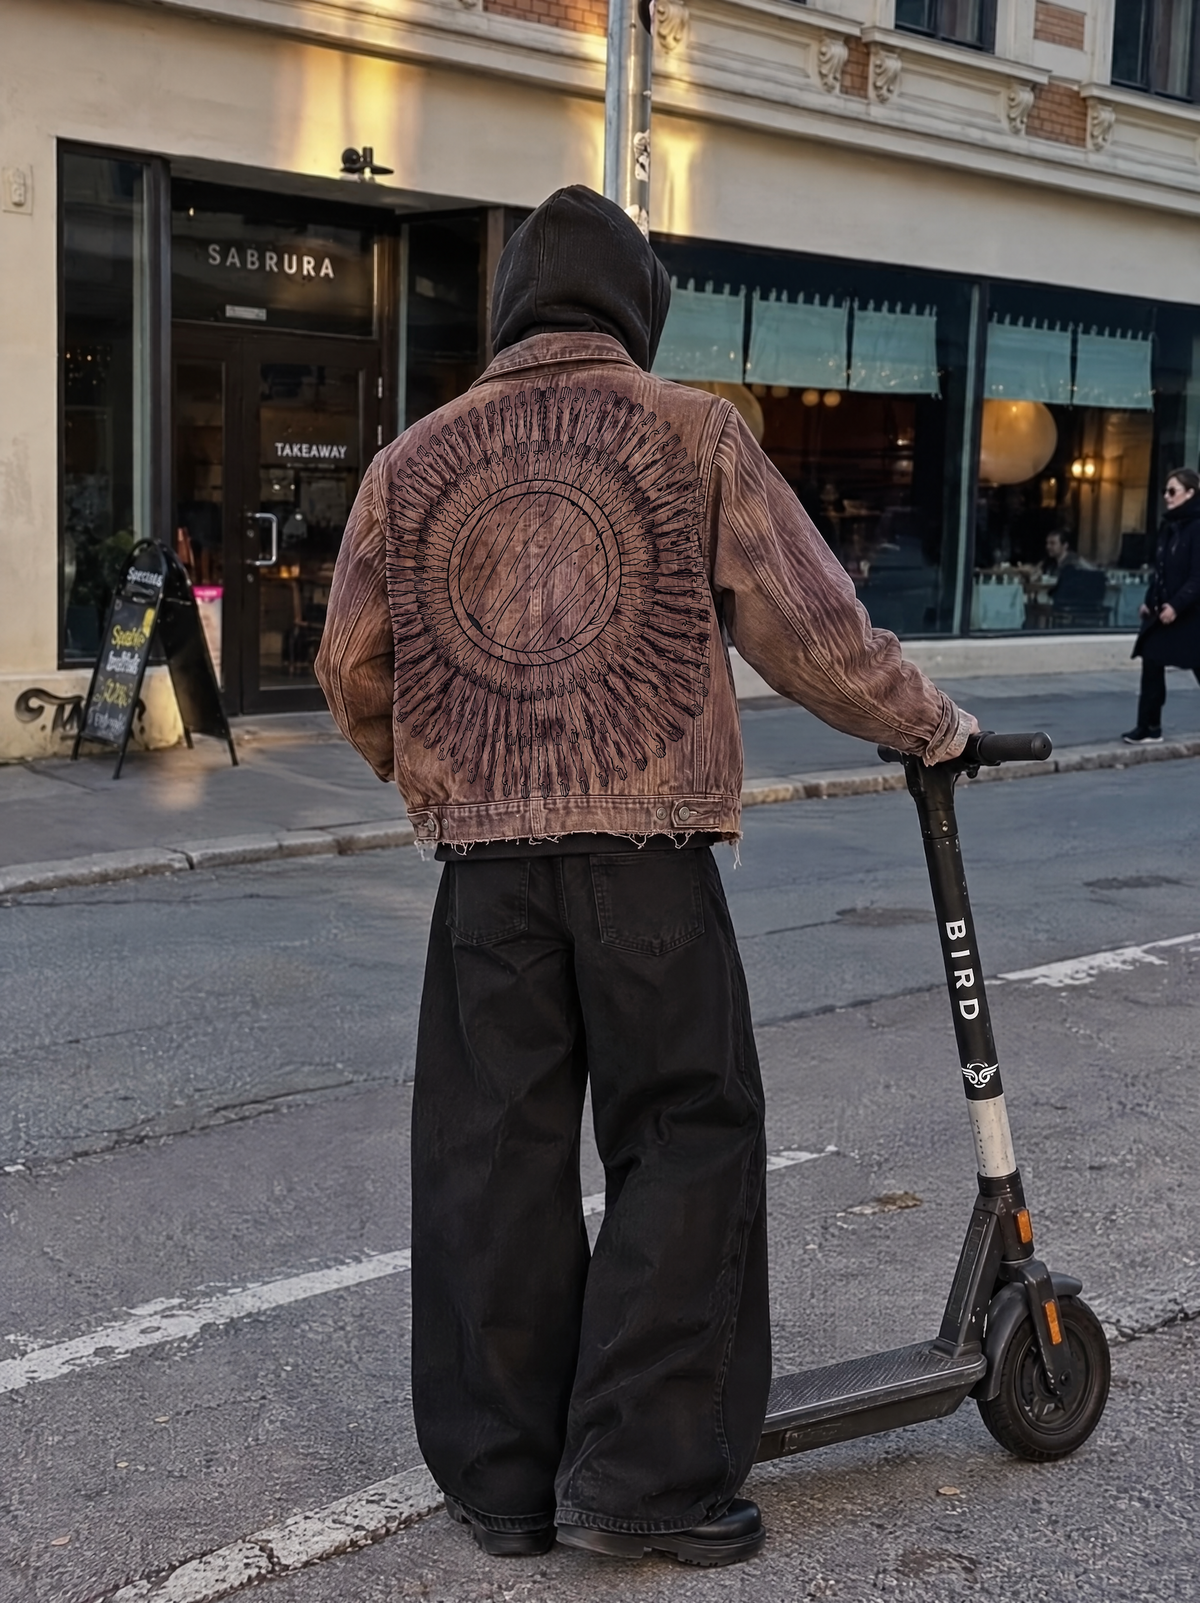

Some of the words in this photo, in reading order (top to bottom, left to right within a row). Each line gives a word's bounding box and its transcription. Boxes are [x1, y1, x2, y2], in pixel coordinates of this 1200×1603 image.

[208, 244, 335, 279] SABRURA
[274, 442, 347, 459] TAKEAWAY
[945, 918, 980, 1020] BIRD
